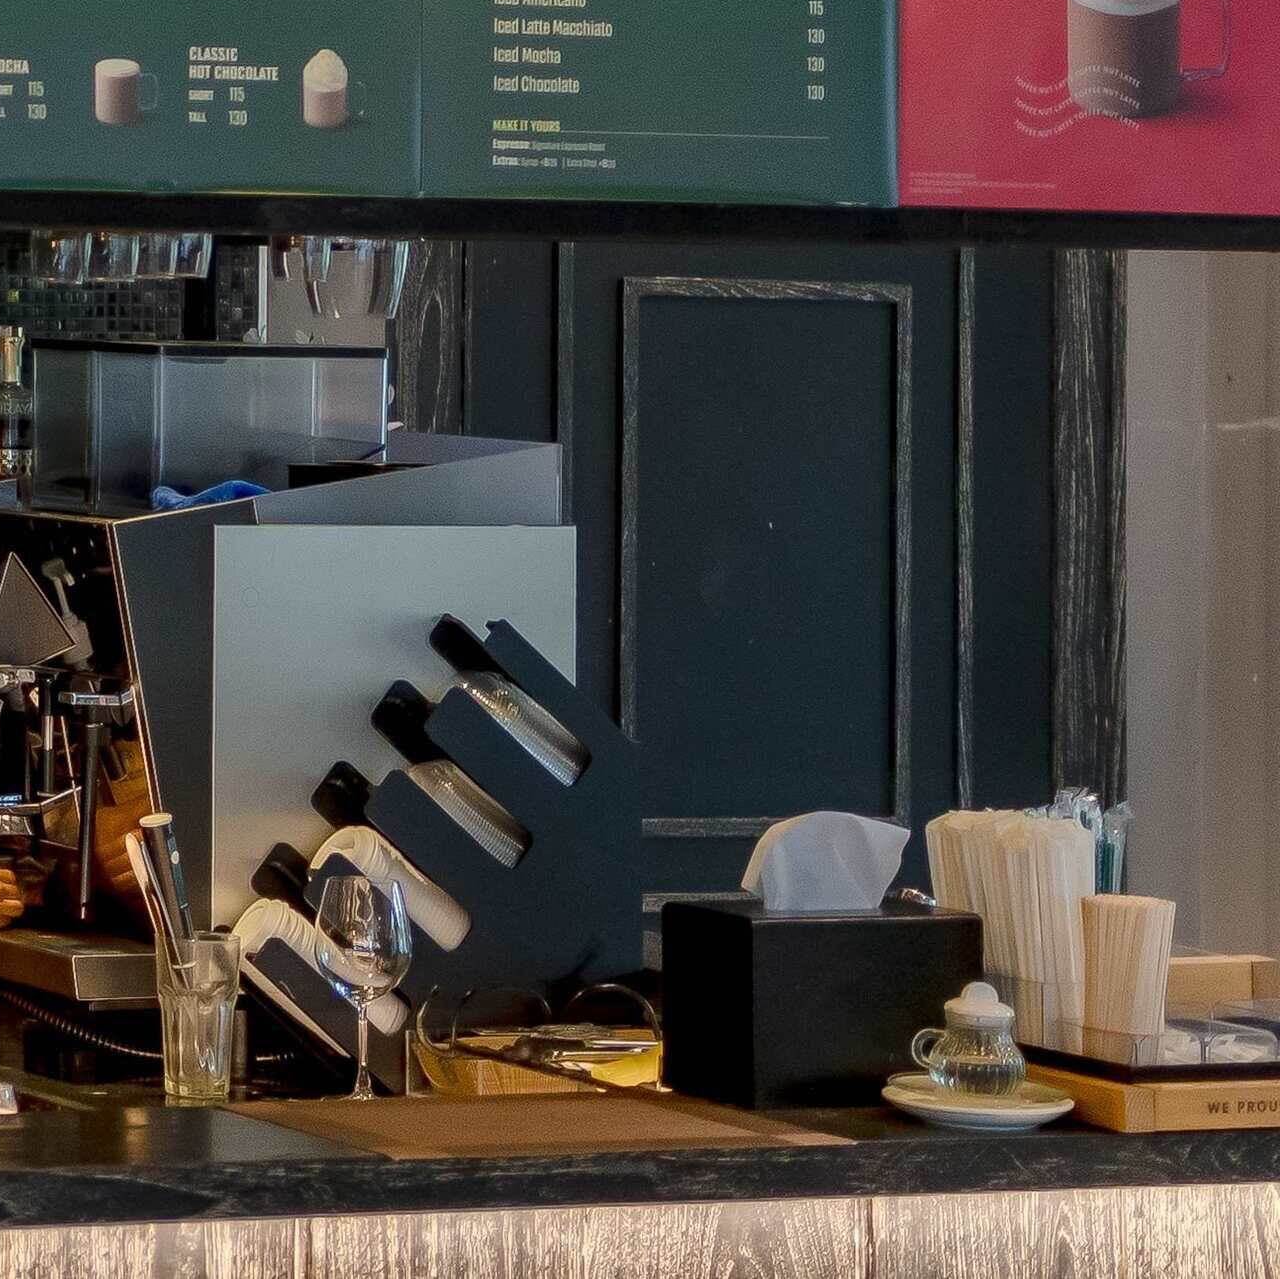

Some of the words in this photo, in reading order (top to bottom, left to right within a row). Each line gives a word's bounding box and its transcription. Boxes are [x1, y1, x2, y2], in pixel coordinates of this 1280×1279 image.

[494, 18, 519, 34] Iced
[521, 19, 551, 36] Latte
[552, 20, 613, 38] Macchiato
[189, 46, 238, 61] CLASSIC
[493, 46, 518, 63] Iced
[521, 47, 561, 64] Mocha
[189, 64, 211, 80] HOT
[214, 66, 279, 81] CHOCOLATE
[493, 75, 518, 92] Iced
[521, 76, 580, 94] Chocolate
[492, 120, 518, 131] MAKE
[1208, 1102, 1229, 1113] WE
[1237, 1100, 1280, 1113] PROU
